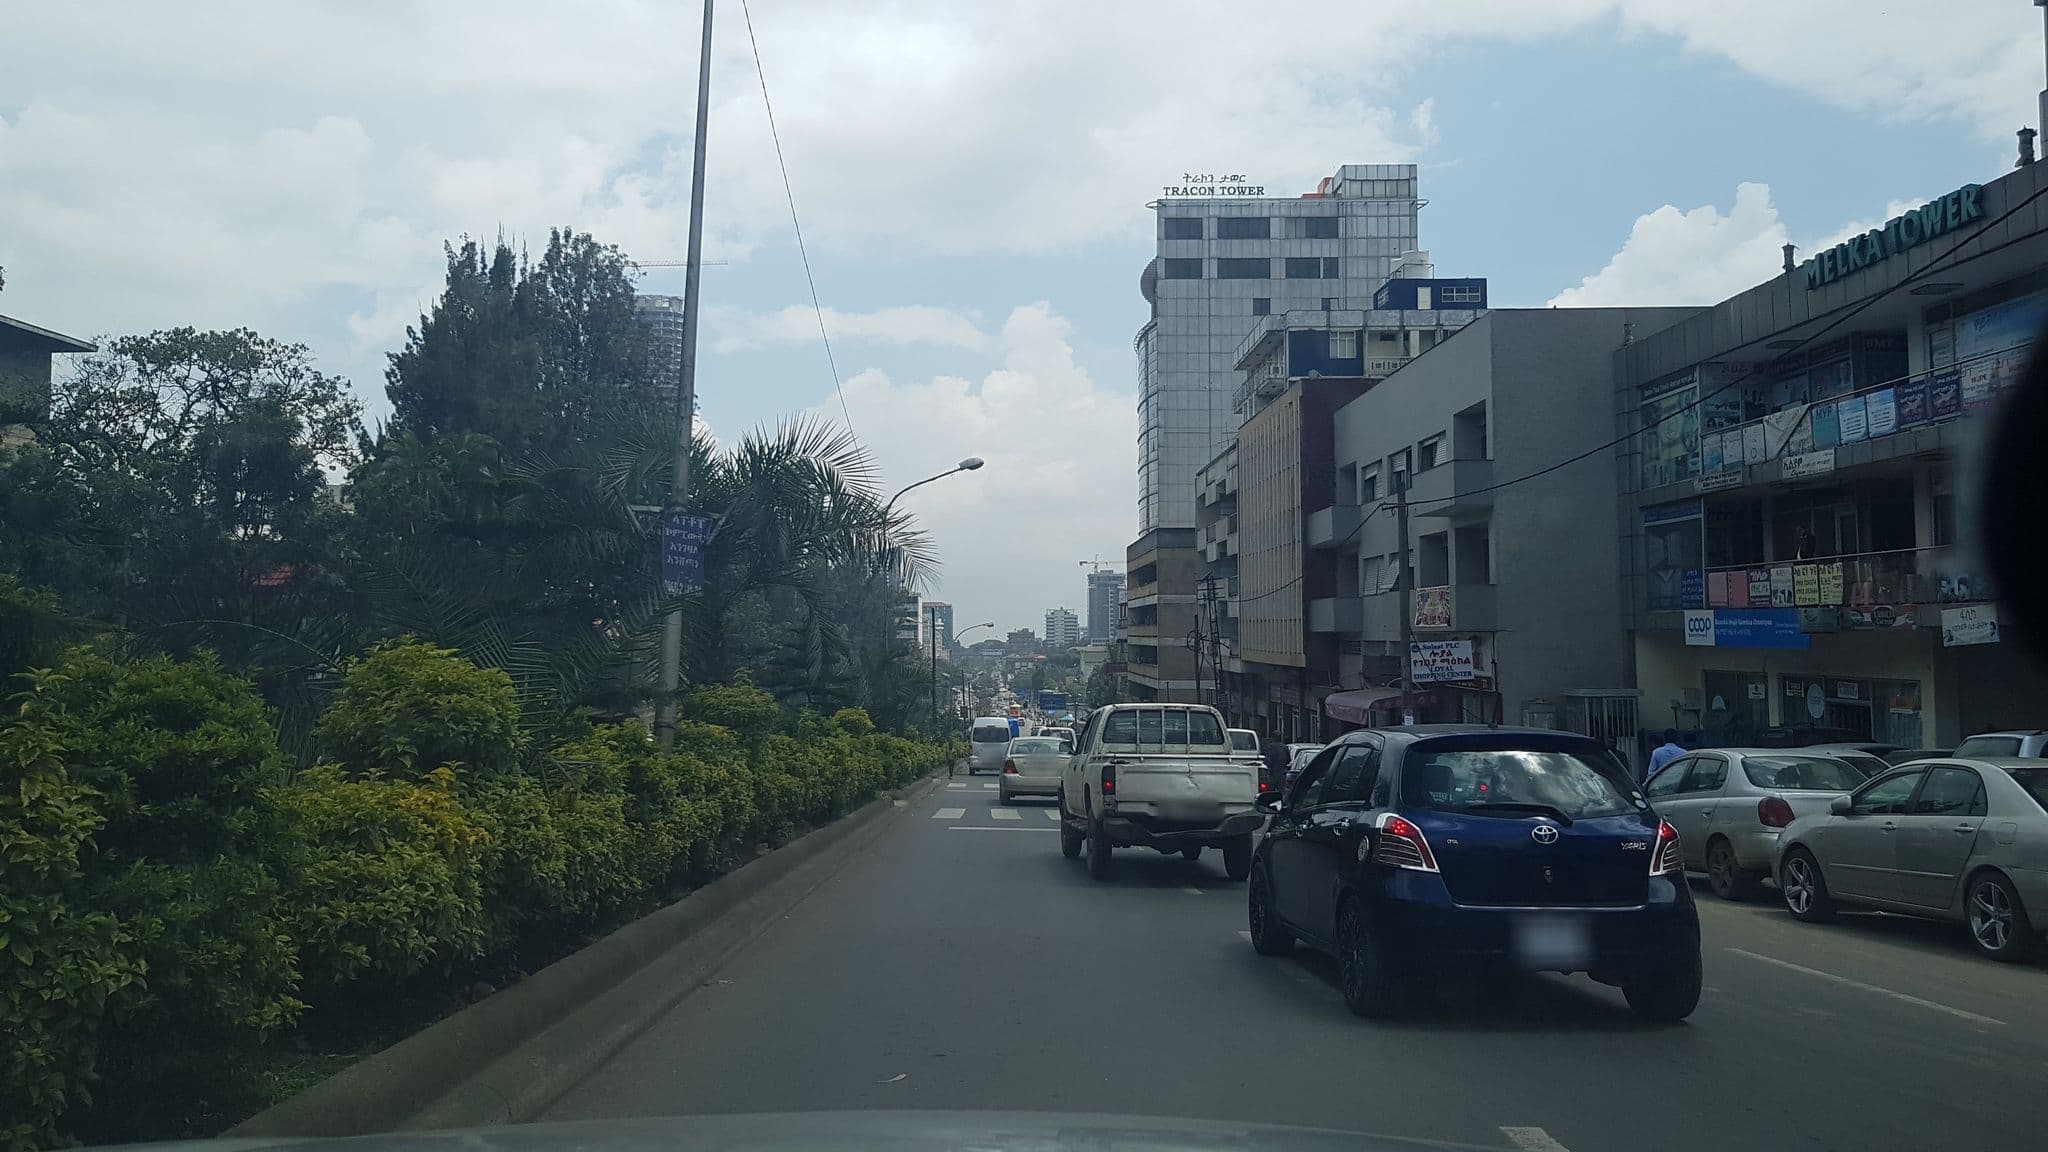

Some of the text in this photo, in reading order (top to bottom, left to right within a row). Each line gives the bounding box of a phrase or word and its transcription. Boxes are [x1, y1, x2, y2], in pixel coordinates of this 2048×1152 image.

[1163, 186, 1265, 196] TRACON TOWER
[1803, 183, 1984, 290] MELKA TOWER
